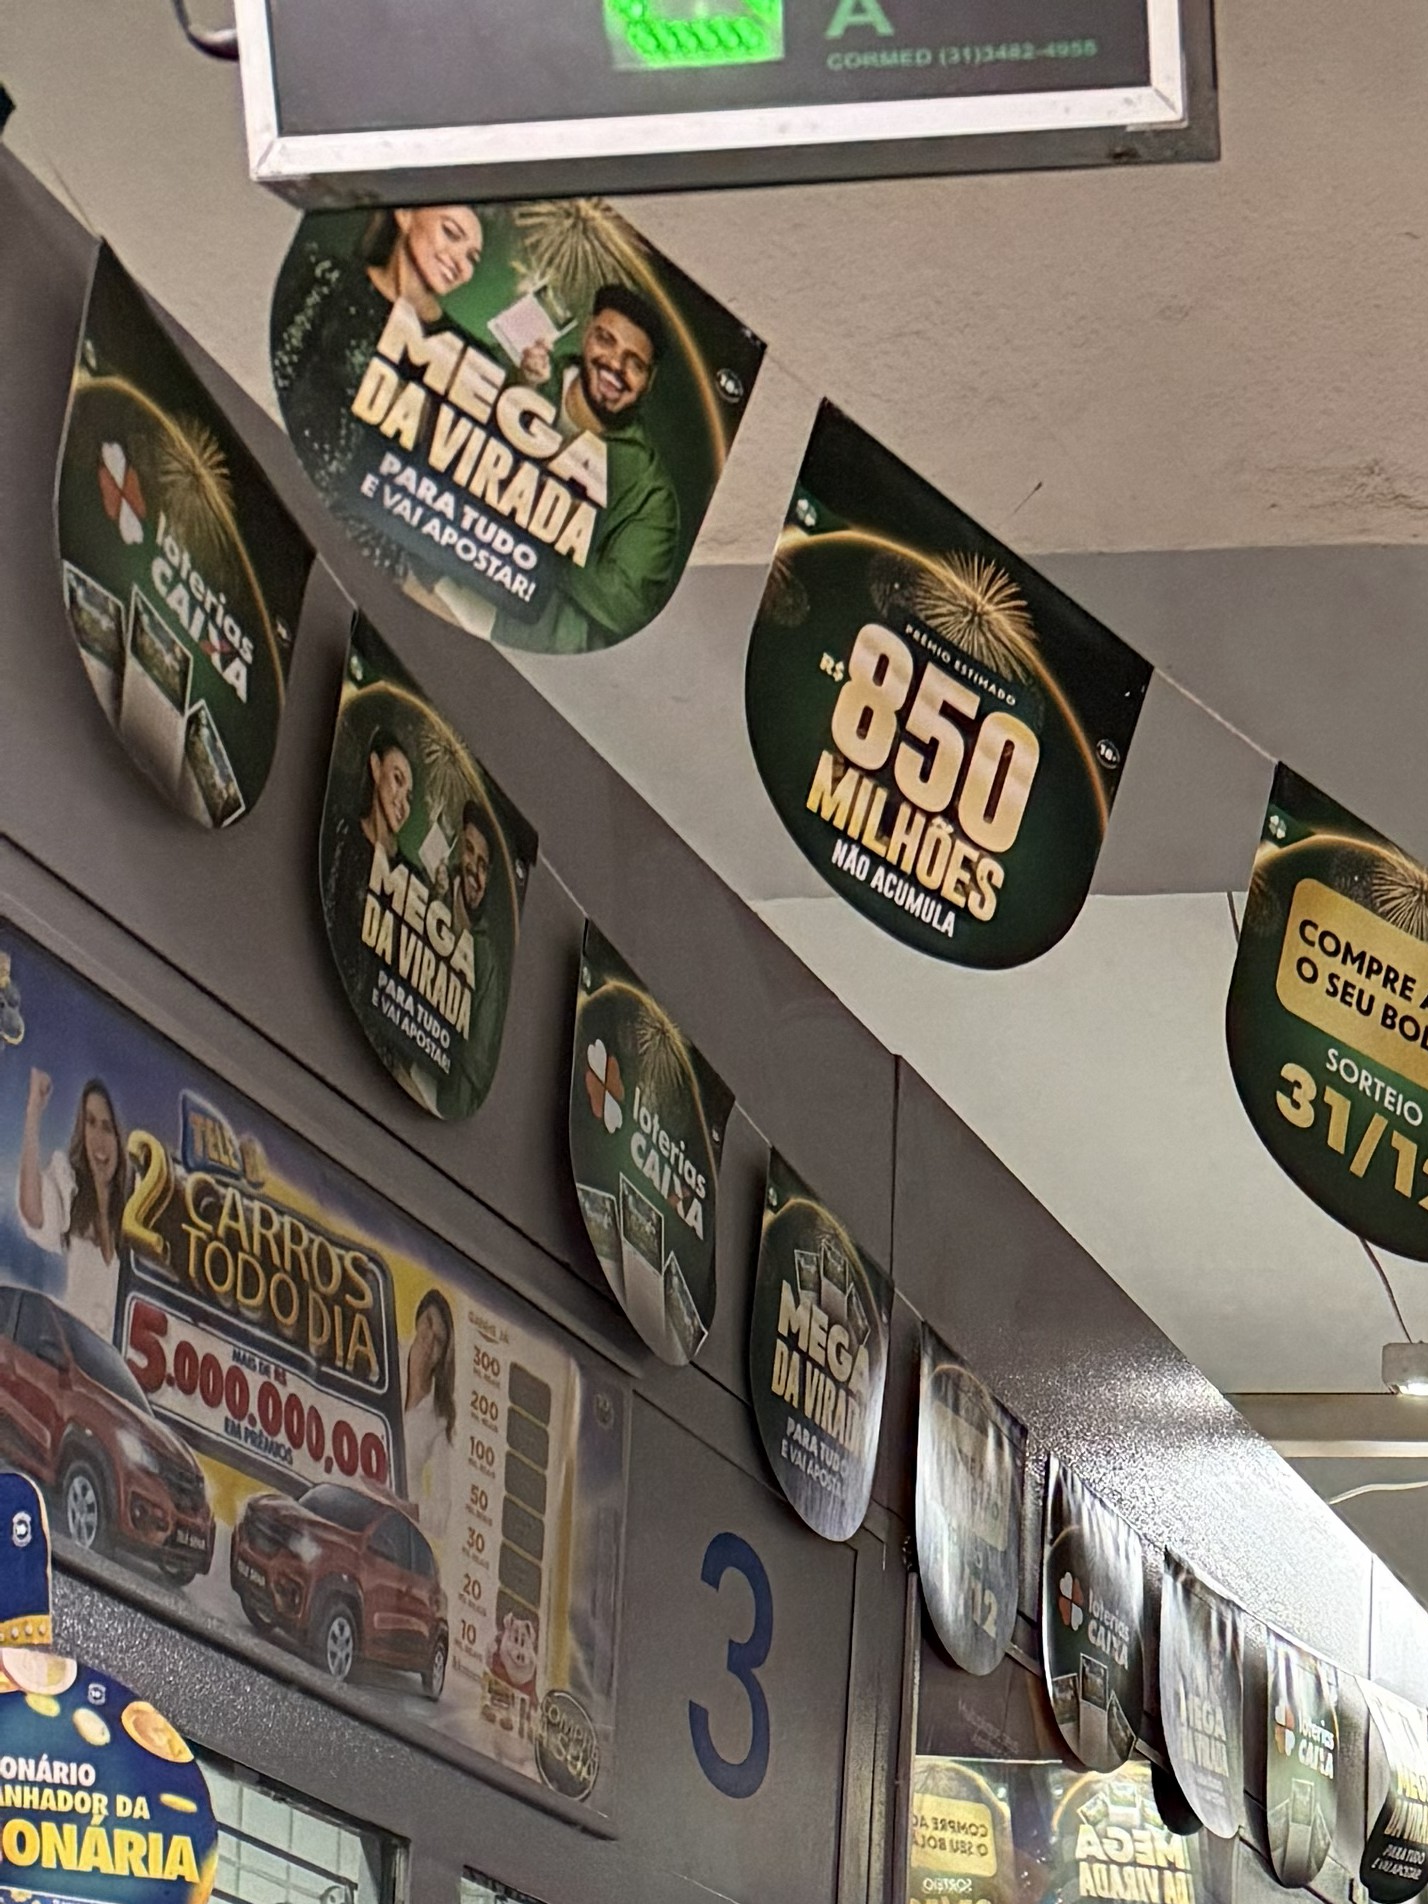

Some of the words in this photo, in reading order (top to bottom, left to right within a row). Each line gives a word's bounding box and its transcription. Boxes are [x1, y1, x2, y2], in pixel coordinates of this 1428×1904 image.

[377, 297, 608, 508] MEGA
[352, 357, 426, 451] DA
[428, 405, 597, 568] VIRADA
[360, 474, 376, 498] E
[383, 490, 420, 528] VAI
[422, 518, 536, 602] APOSTAR!
[379, 452, 455, 521] PARA
[460, 507, 537, 571] TUDO
[820, 652, 844, 682] R$
[905, 624, 950, 663] PRÊMIO
[955, 659, 1016, 706] ESTIMADO
[831, 623, 1040, 853] 850
[807, 750, 1004, 922] MILHÕES
[832, 839, 868, 881] NÃO
[871, 865, 956, 938] ACUMULA
[1296, 957, 1319, 984] O
[1326, 973, 1374, 1017] SEU
[1299, 919, 1416, 1002] COMPRE
[1326, 1048, 1423, 1126] SORTEIO
[122, 1130, 169, 1257] 2
[185, 1172, 372, 1310] CARROS
[182, 1223, 299, 1328] TODO
[308, 1288, 379, 1383] DIA
[126, 1301, 387, 1485] 5.000.000,00
[473, 1345, 501, 1376] 300
[772, 1338, 798, 1408] DA
[470, 1391, 499, 1420] 200
[469, 1436, 494, 1466] 100
[470, 1485, 489, 1512] 50
[467, 1527, 485, 1554] 30
[463, 1573, 482, 1600] 20
[688, 1531, 773, 1798] 3
